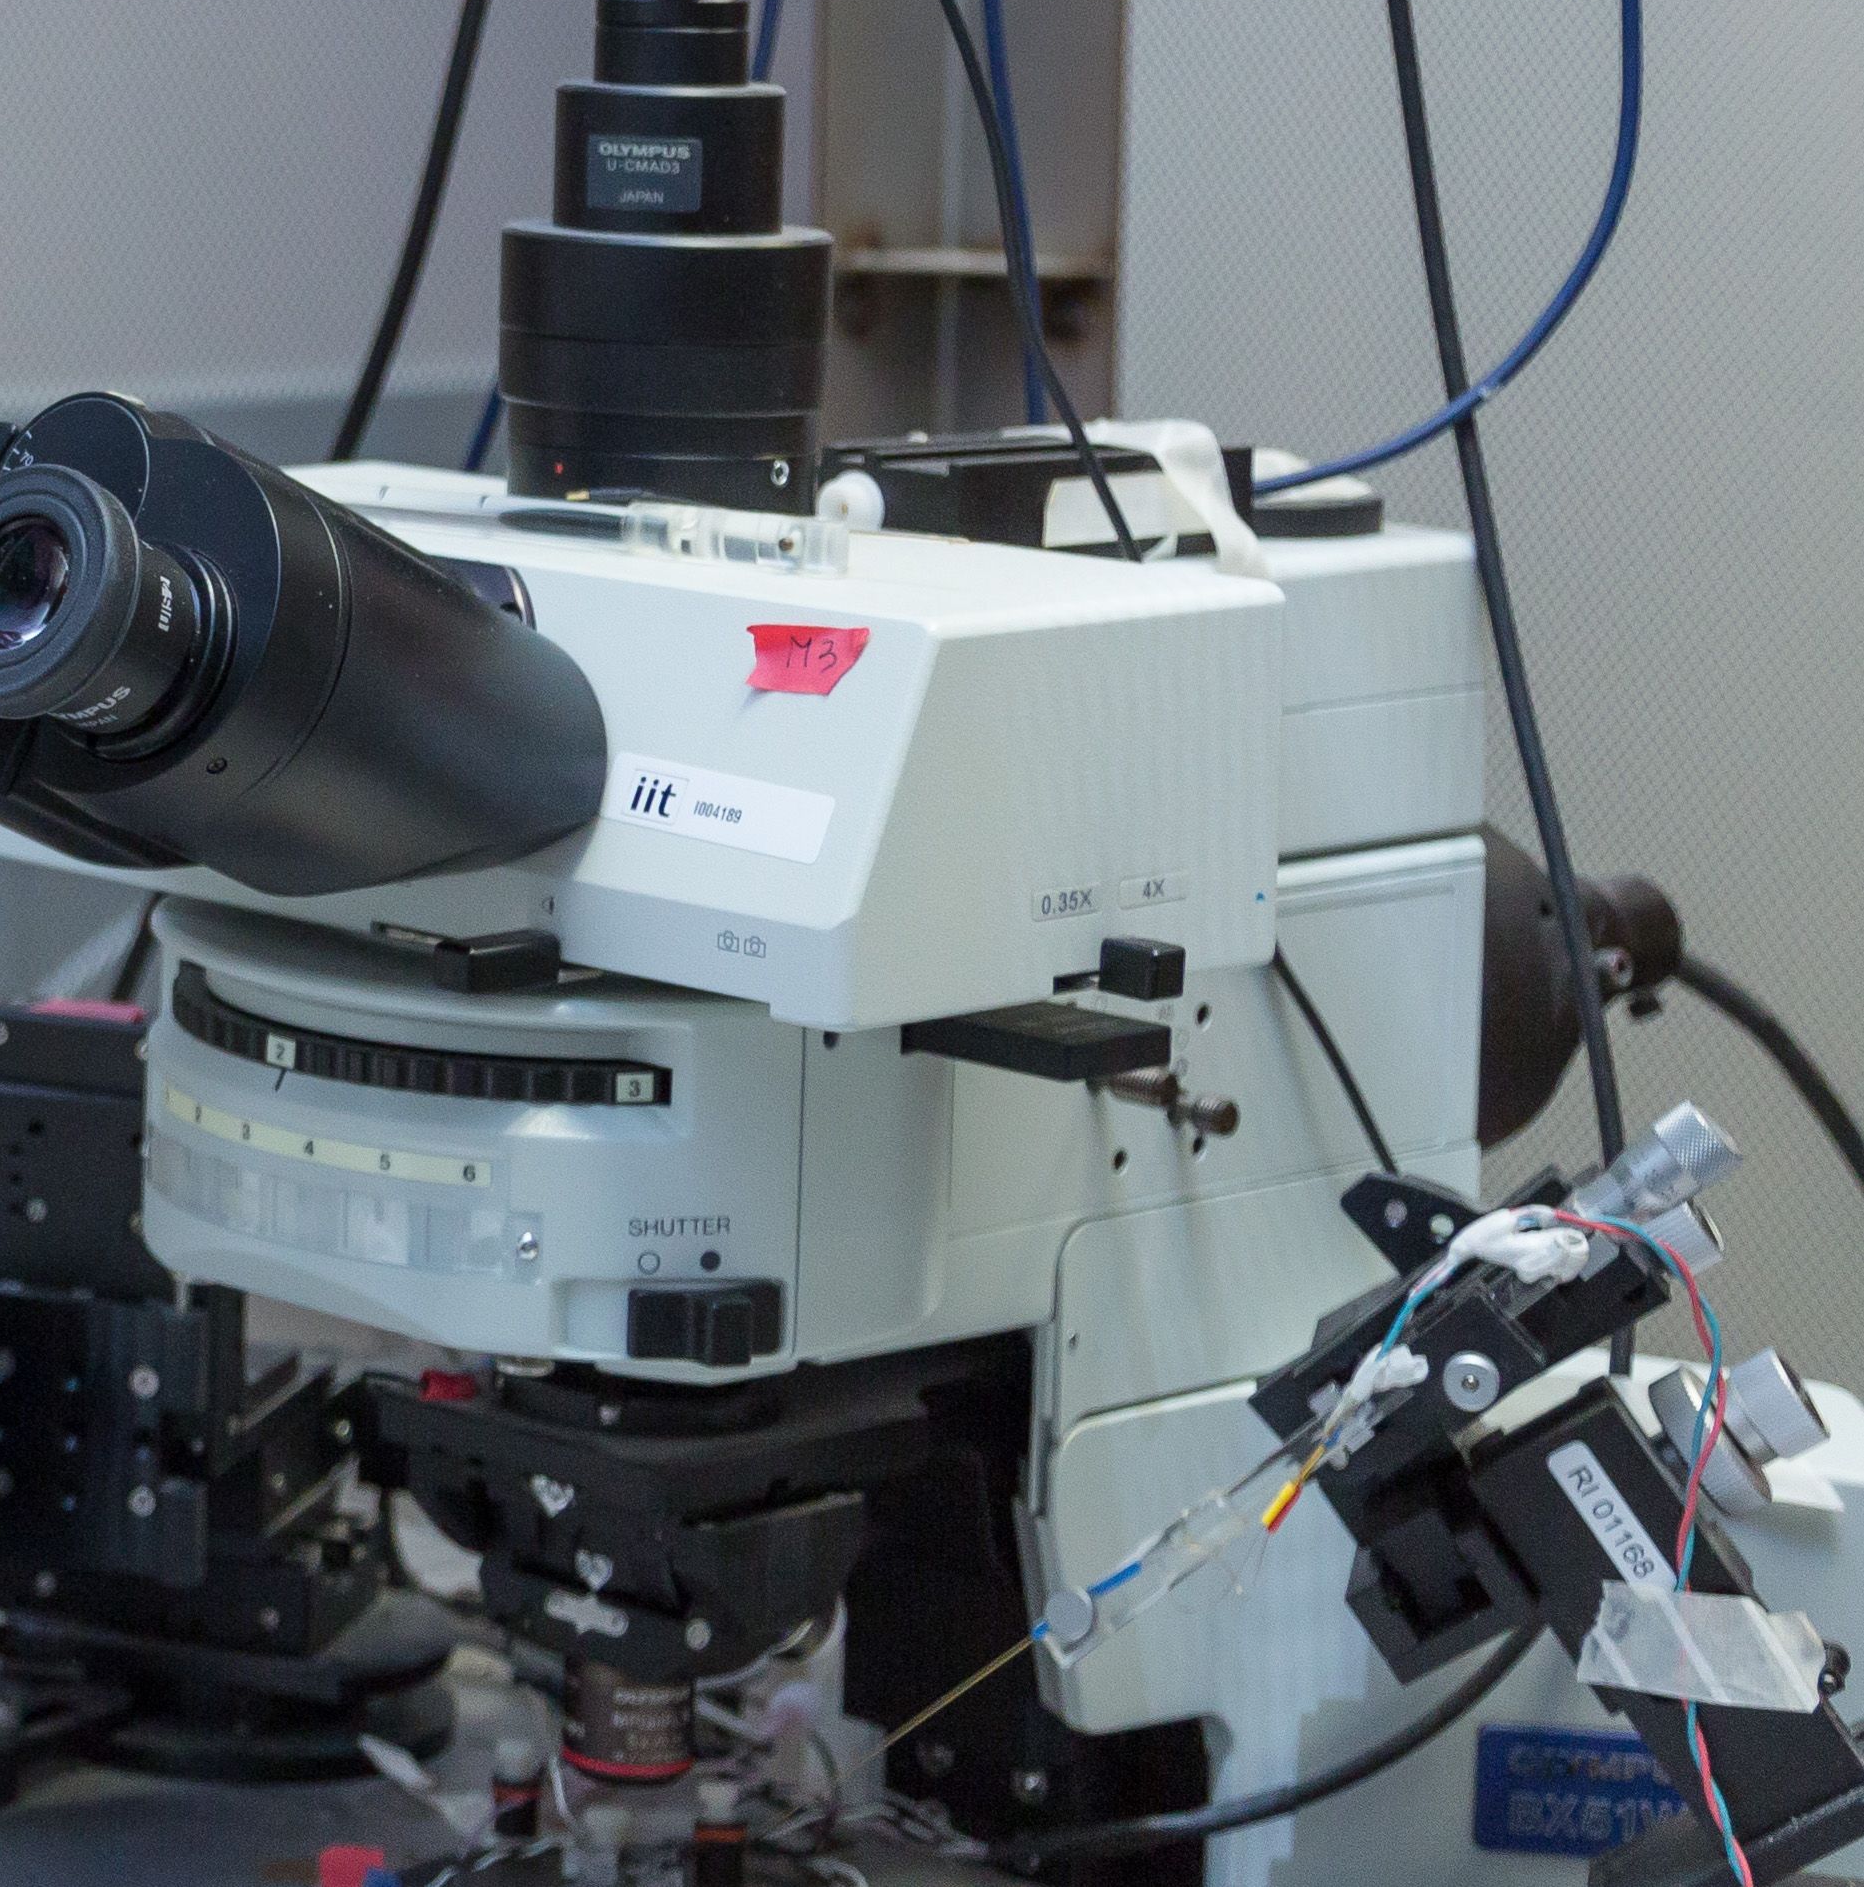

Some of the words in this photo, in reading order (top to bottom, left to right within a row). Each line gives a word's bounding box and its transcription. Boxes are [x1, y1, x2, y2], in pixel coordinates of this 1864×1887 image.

[599, 141, 691, 160] OLYMPUS
[620, 190, 664, 203] JAPAN
[786, 636, 838, 673] M3
[630, 776, 677, 818] iit
[1142, 878, 1166, 899] 4X
[1041, 889, 1093, 915] 0.35X
[275, 1042, 286, 1060] 2
[629, 1079, 641, 1098] 3
[242, 1123, 250, 1140] 3
[304, 1140, 314, 1156] 4
[380, 1153, 390, 1171] 5
[463, 1163, 476, 1182] 6
[628, 1216, 731, 1237] SHUTTER
[1592, 1498, 1655, 1579] 01168
